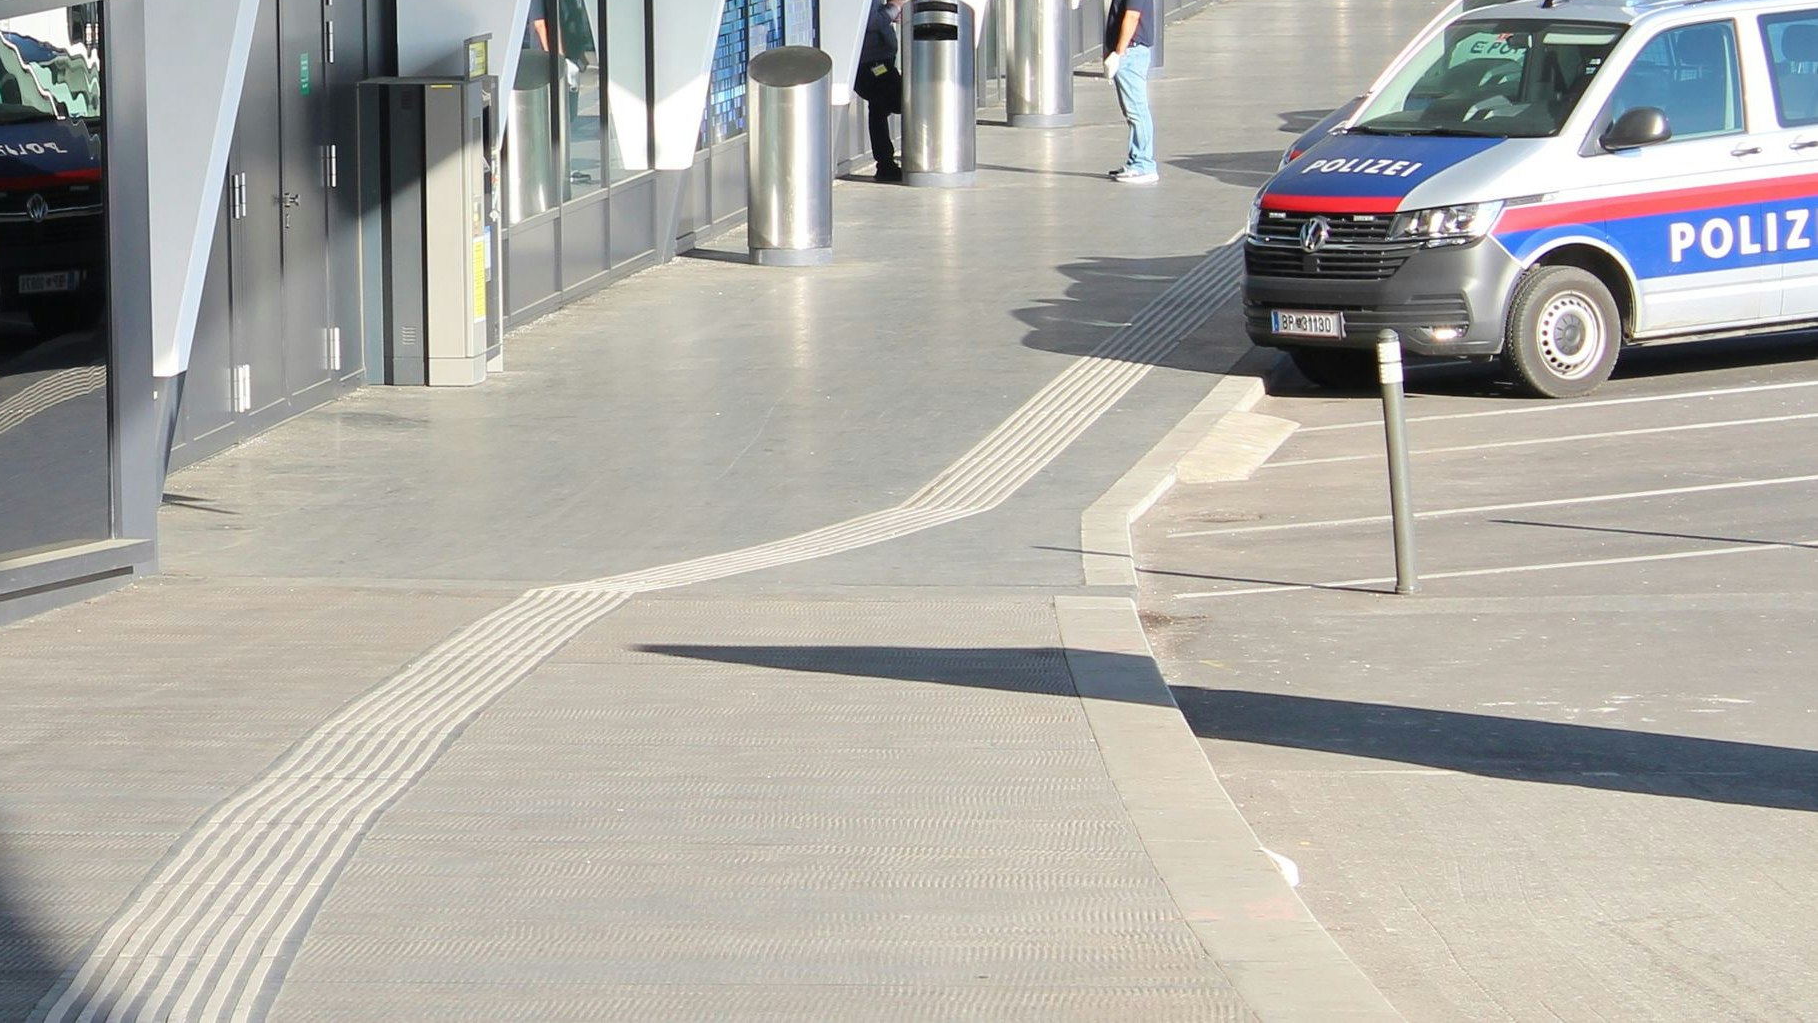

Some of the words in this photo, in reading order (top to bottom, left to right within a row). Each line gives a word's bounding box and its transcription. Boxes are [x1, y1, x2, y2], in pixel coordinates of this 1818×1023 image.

[1301, 157, 1423, 178] POLIZEI
[1669, 208, 1818, 263] POLIZ
[1281, 314, 1294, 330] BP
[1301, 316, 1332, 332] 31130
